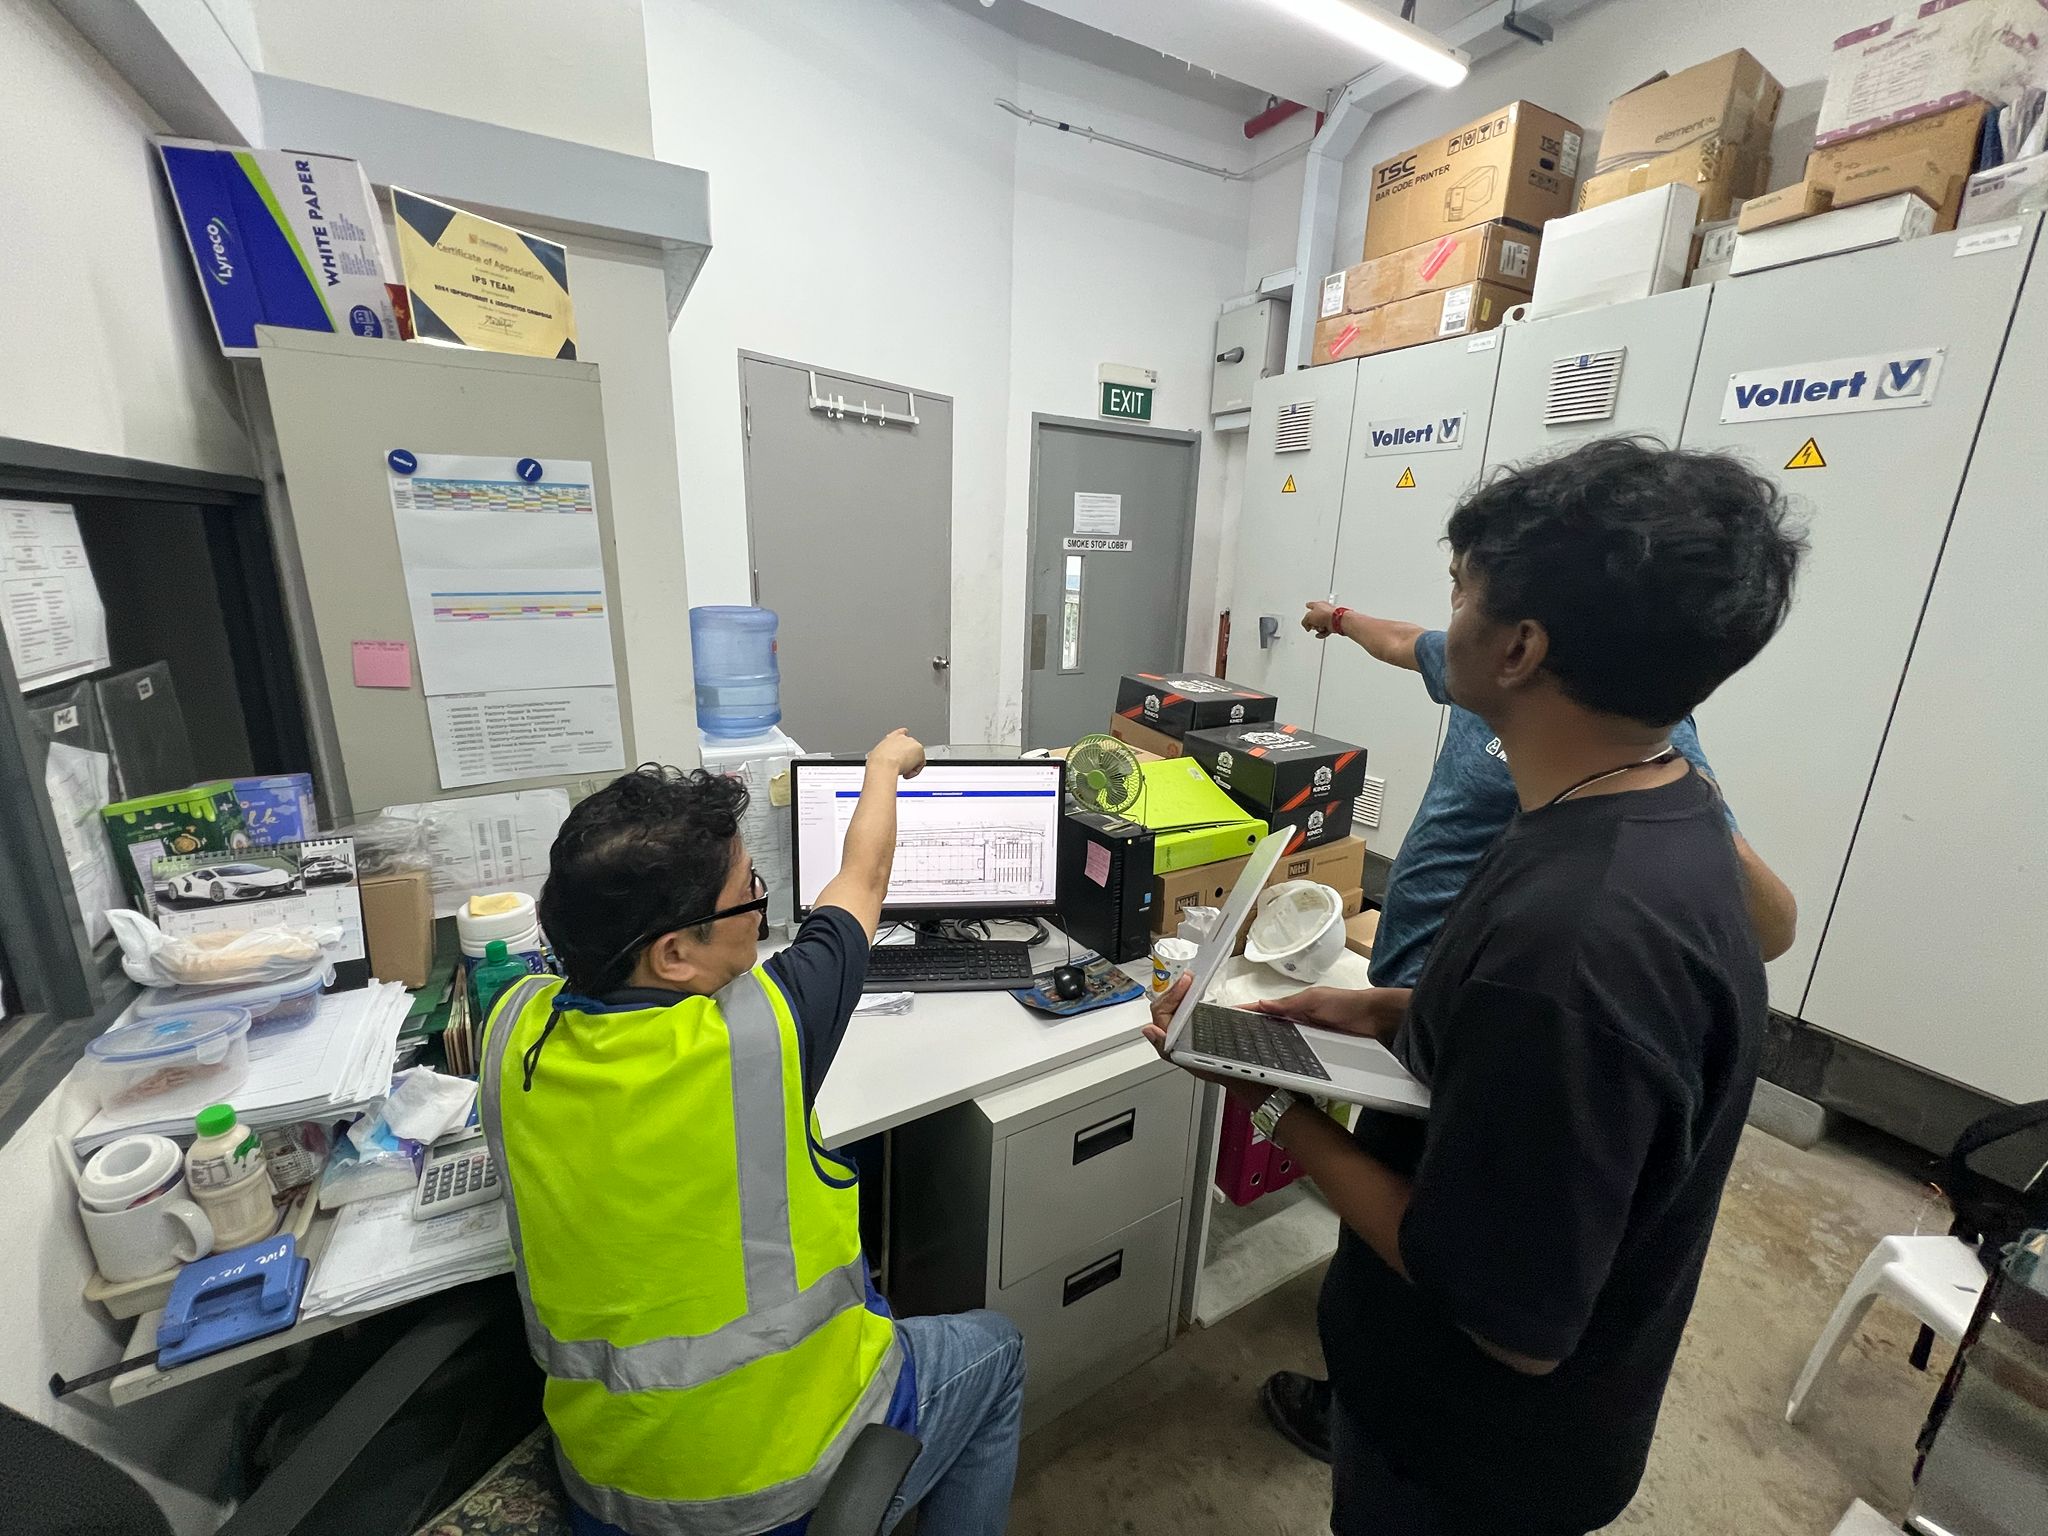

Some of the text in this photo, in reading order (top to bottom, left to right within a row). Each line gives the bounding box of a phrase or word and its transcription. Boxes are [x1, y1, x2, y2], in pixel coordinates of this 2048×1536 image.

[1541, 136, 1562, 152] TSC
[1375, 164, 1451, 201] BAR CODE PRINTER
[1378, 155, 1417, 184] TSC
[295, 160, 341, 287] WHITE PAPER
[207, 223, 233, 279] Lyreco
[437, 242, 482, 264] Certificate
[483, 258, 492, 266] of
[494, 260, 544, 282] Appreciation
[472, 274, 515, 293] IPS TEAM
[1110, 388, 1144, 414] EXIT
[1736, 371, 1867, 409] Vollert
[1372, 424, 1433, 447] Vollert
[1067, 539, 1128, 549] SMOKE STOP LOBBY
[1289, 863, 1307, 875] Nitti
